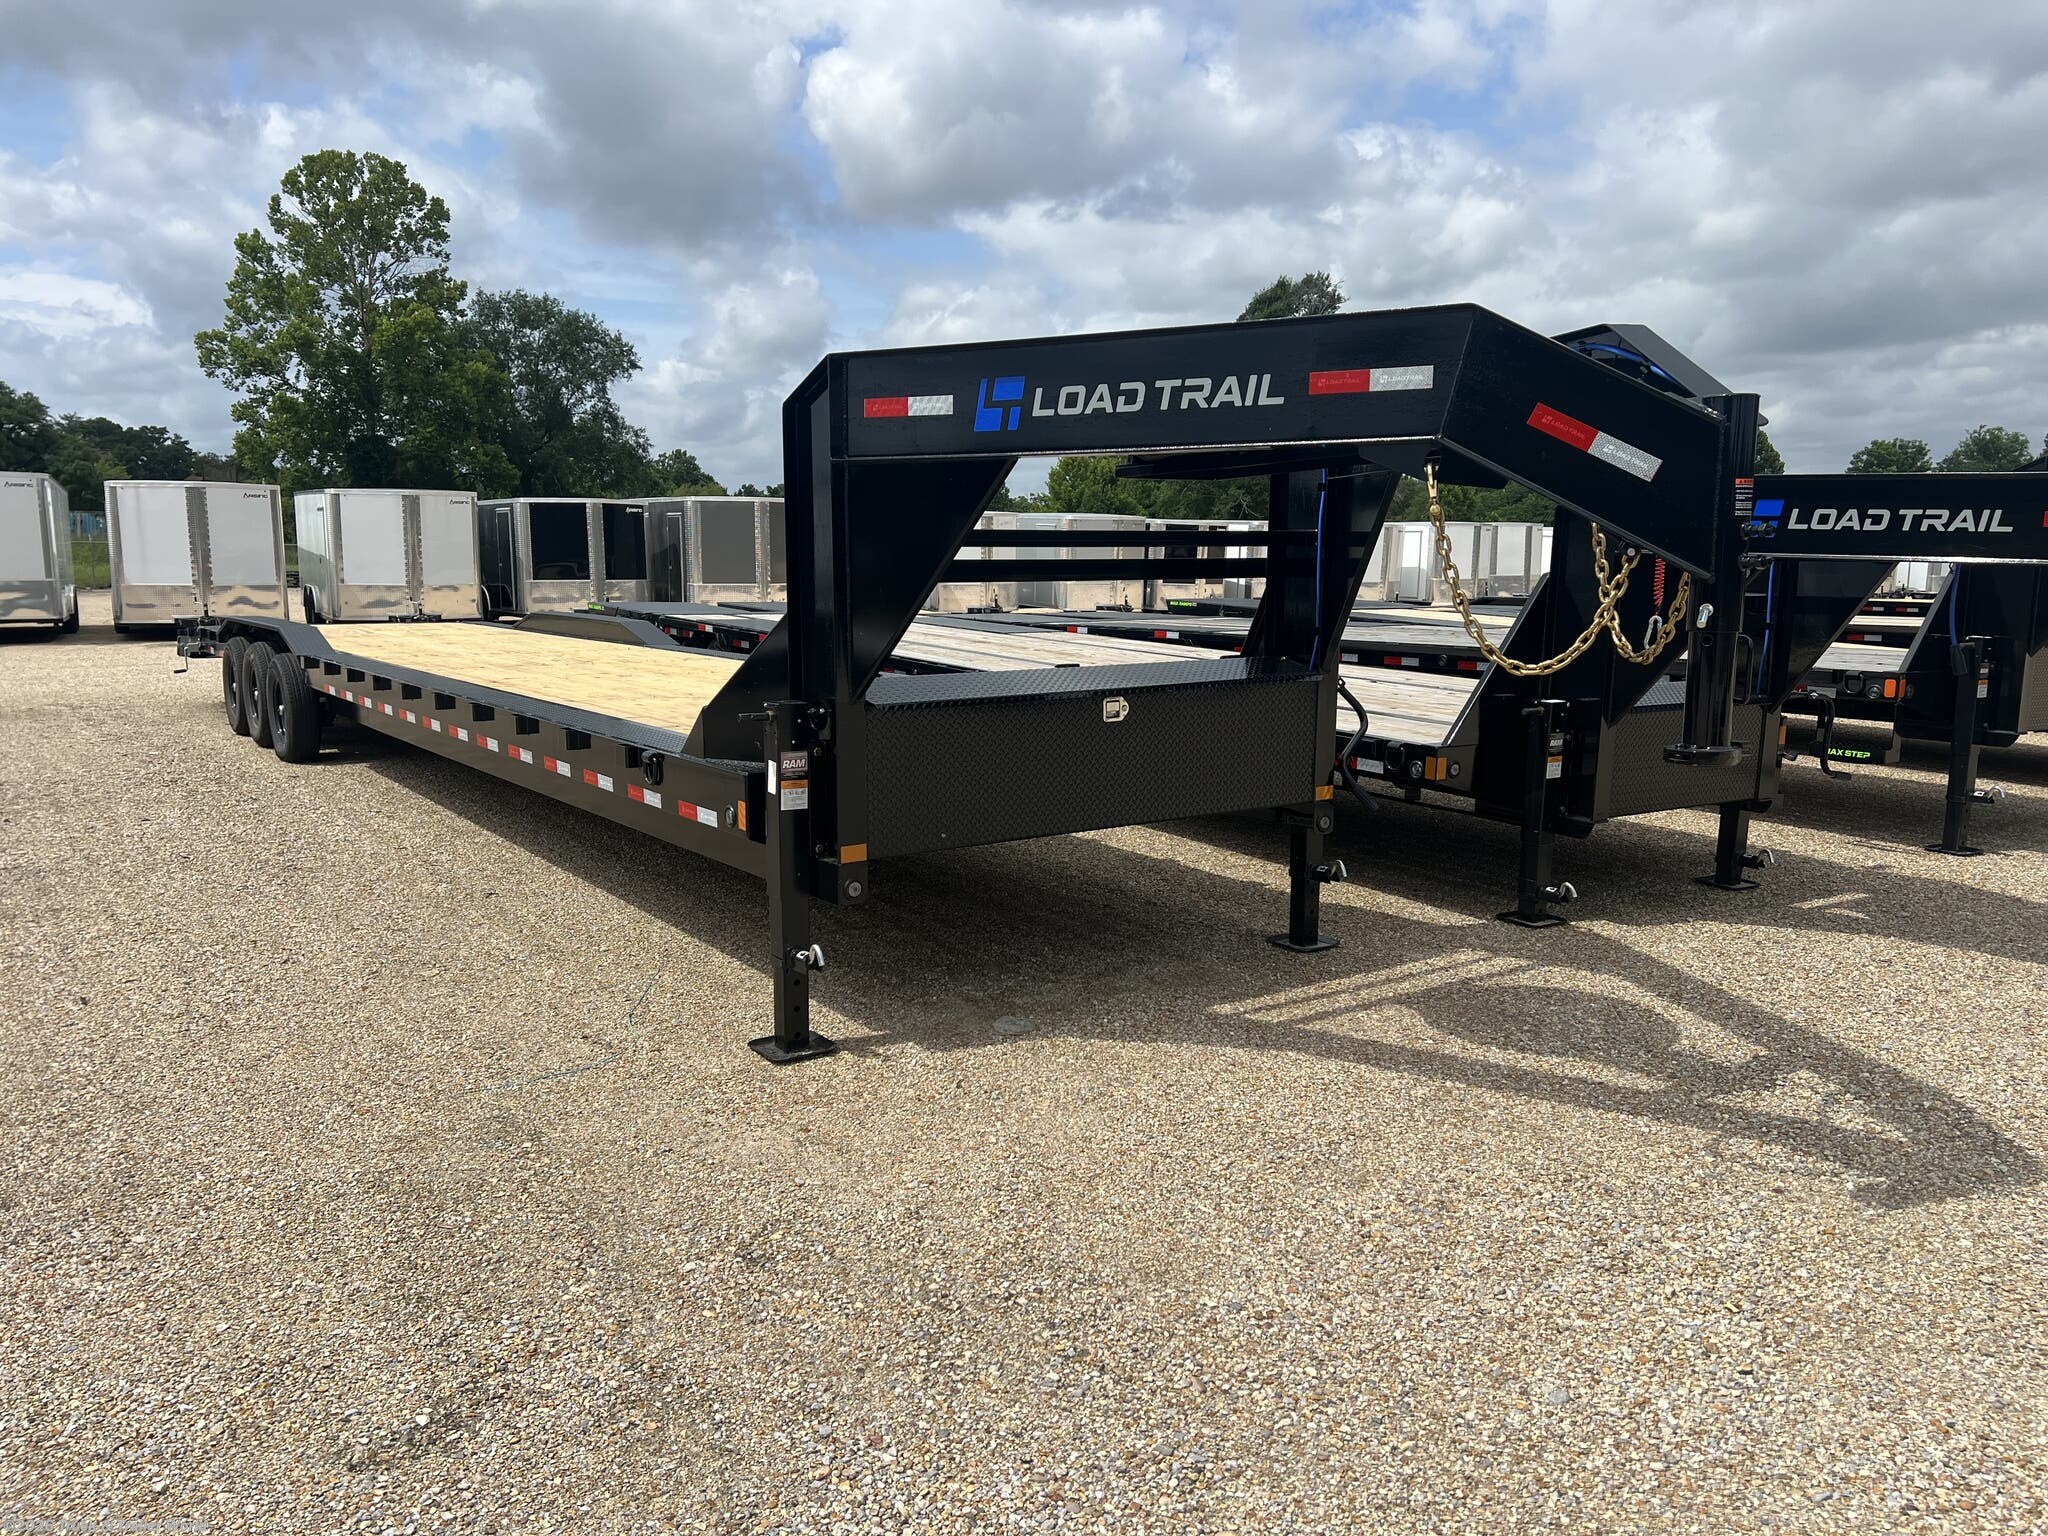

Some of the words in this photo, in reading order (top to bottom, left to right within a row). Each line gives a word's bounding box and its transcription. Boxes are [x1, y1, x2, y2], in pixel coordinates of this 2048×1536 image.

[1032, 381, 1146, 417] LOAD
[1154, 373, 1285, 411] TRAIL
[1787, 508, 1891, 531] LOAD
[1898, 508, 2014, 533] TRAIL
[1844, 750, 1871, 759] STEP
[782, 759, 806, 769] RAM
